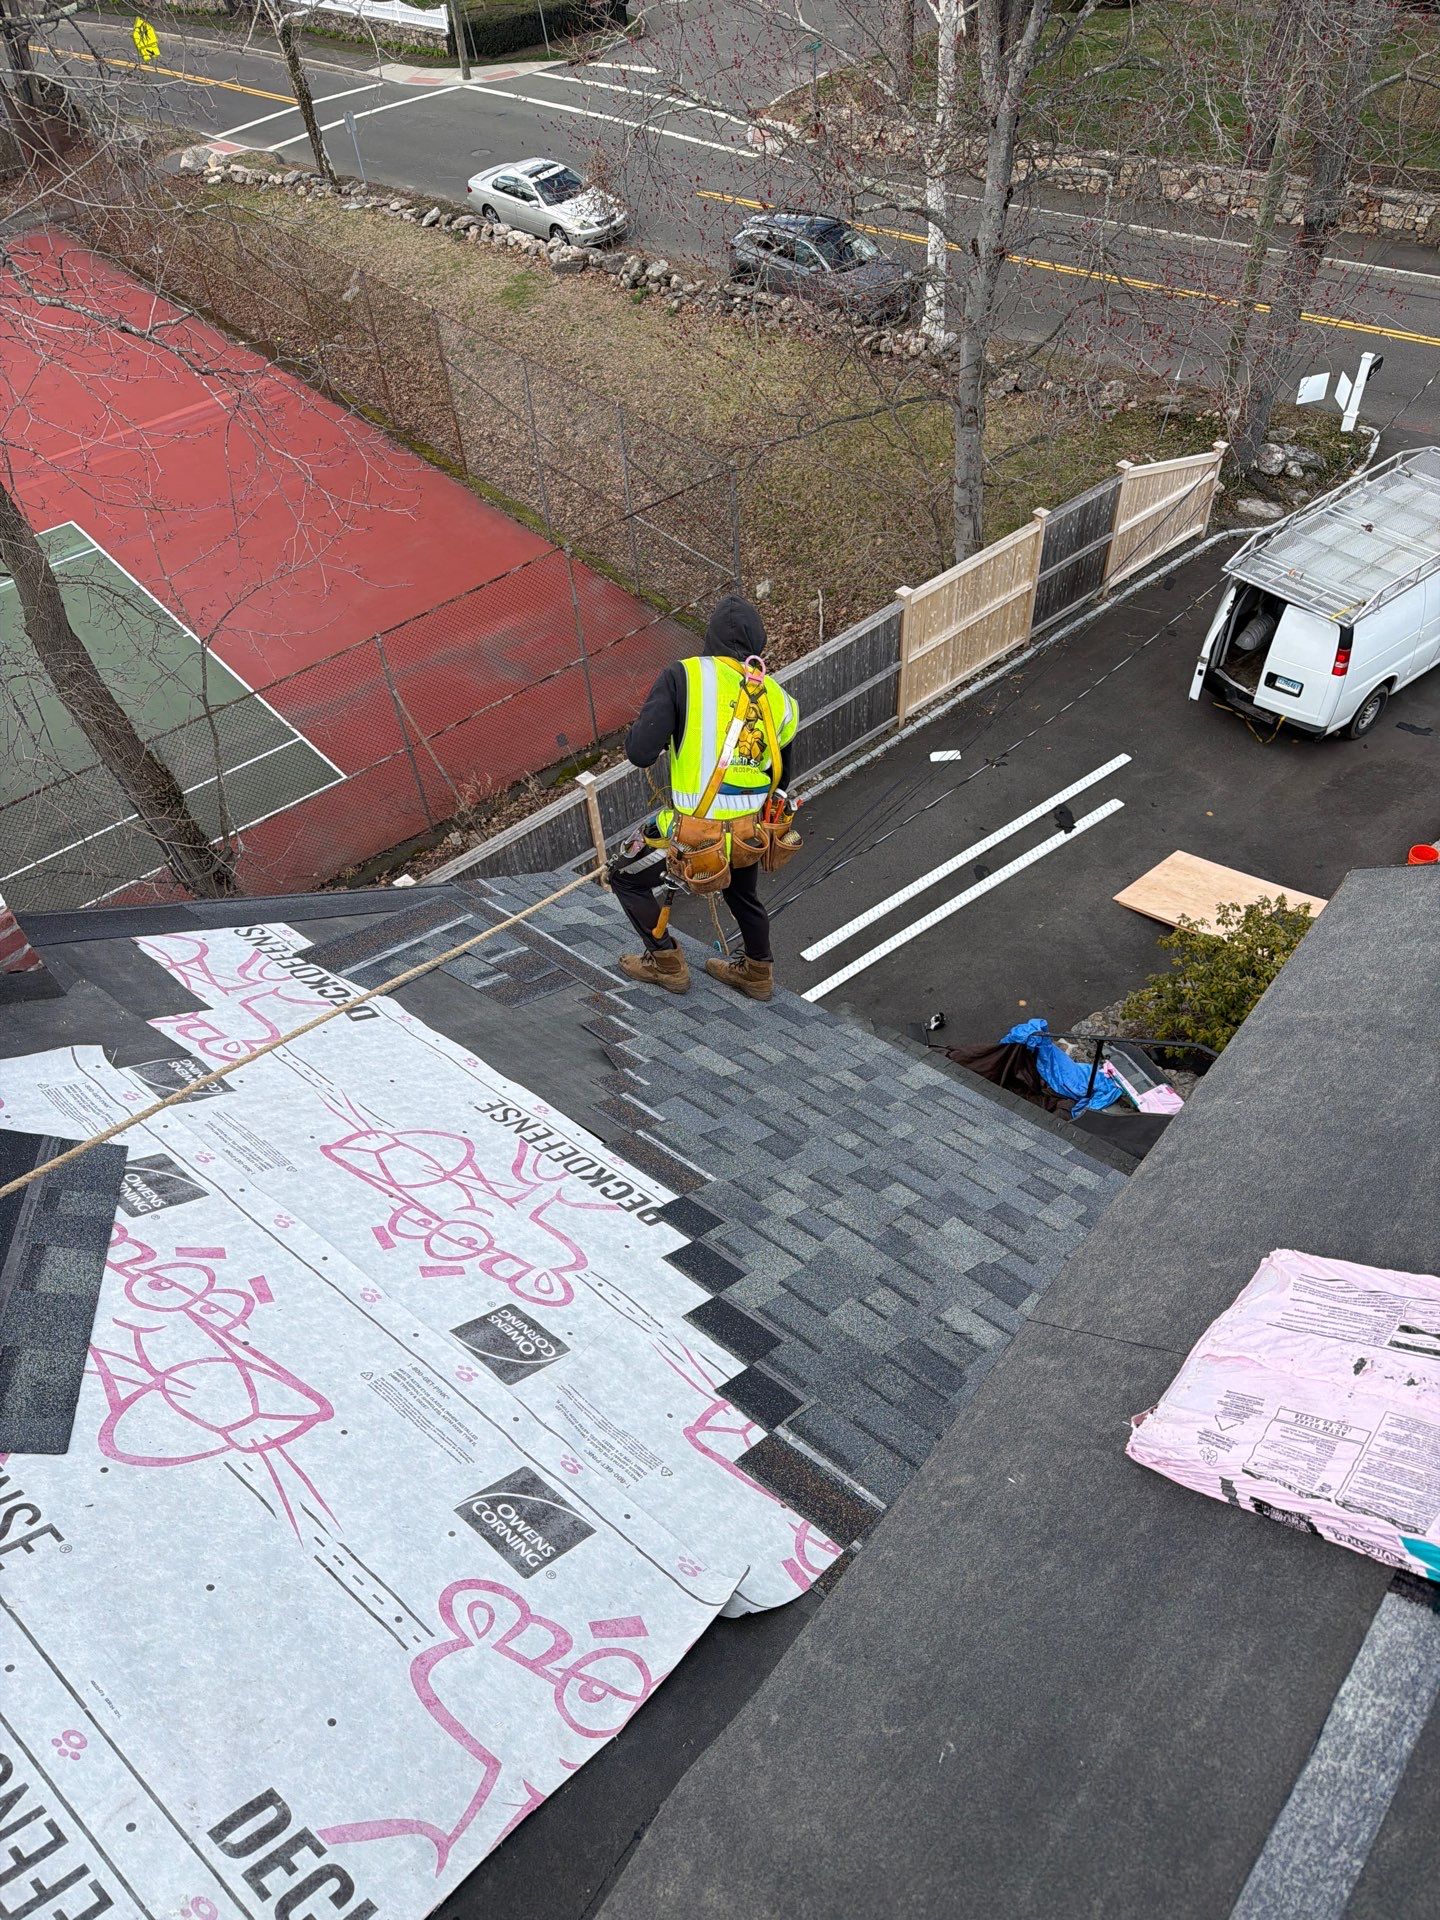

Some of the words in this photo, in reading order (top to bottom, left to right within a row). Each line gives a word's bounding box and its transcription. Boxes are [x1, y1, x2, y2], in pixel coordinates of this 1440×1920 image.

[168, 1061, 203, 1089] WENS
[180, 1059, 223, 1092] CONING
[125, 1173, 167, 1208] OWENS
[487, 1315, 535, 1356] OWENS
[497, 1309, 556, 1358] CORNING
[1322, 1425, 1346, 1435] ASTM
[471, 1500, 542, 1568] CORNING
[495, 1502, 556, 1558] OWENS
